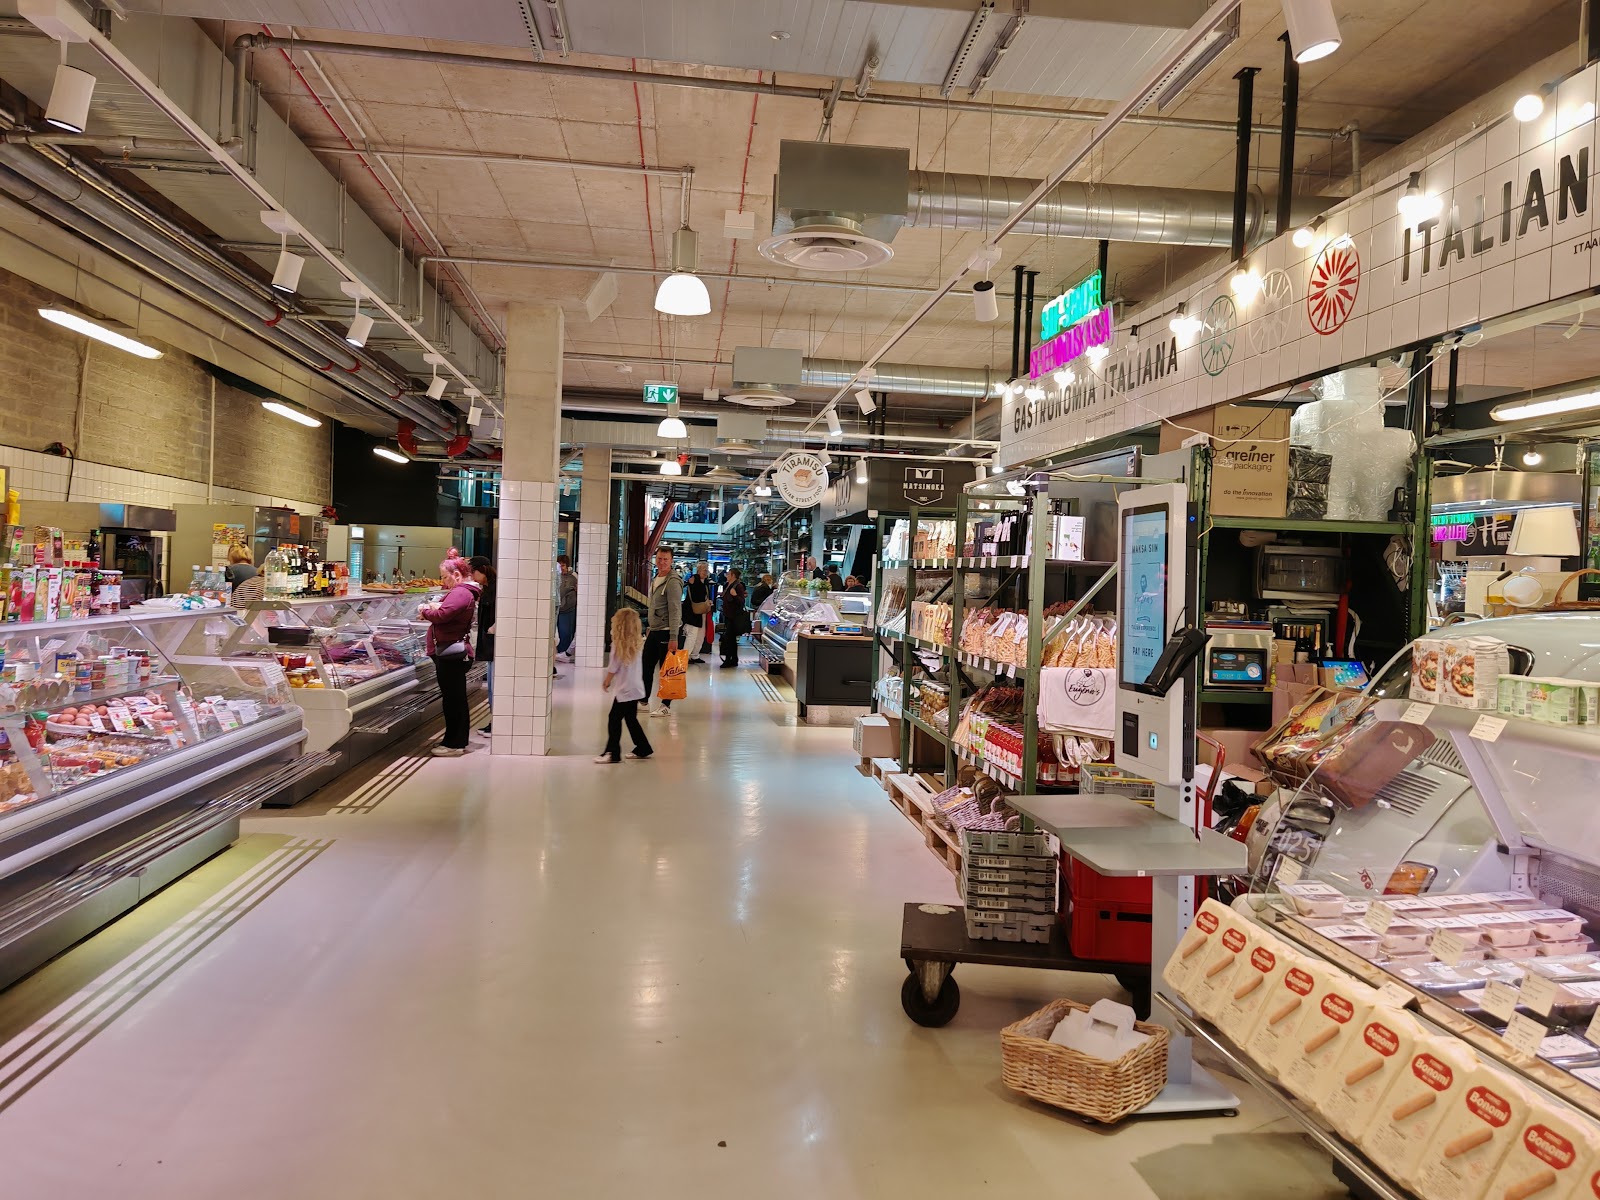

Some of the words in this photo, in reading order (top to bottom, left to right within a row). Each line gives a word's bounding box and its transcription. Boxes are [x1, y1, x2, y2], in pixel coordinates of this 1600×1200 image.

[1402, 147, 1589, 284] ITALIAN
[1014, 375, 1096, 434] GASTRONOMIA
[1104, 336, 1178, 400] ITALIANA
[1226, 445, 1275, 463] greiner
[782, 457, 824, 477] TIRAMISU
[1233, 462, 1272, 473] packaging
[782, 482, 795, 500] ITALIAN
[795, 496, 813, 504] STREET
[813, 485, 823, 499] FOOD
[1242, 488, 1273, 497] innovation
[1131, 545, 1147, 554] MAKSA
[1132, 646, 1142, 656] PAY
[1142, 647, 1154, 658] HERE
[1322, 997, 1352, 1019] Bonomi
[1366, 1026, 1397, 1052] Bonomi
[1415, 1057, 1450, 1086] Bonomi
[1469, 1091, 1508, 1122] Bonomi
[1527, 1129, 1571, 1164] Bonomi
